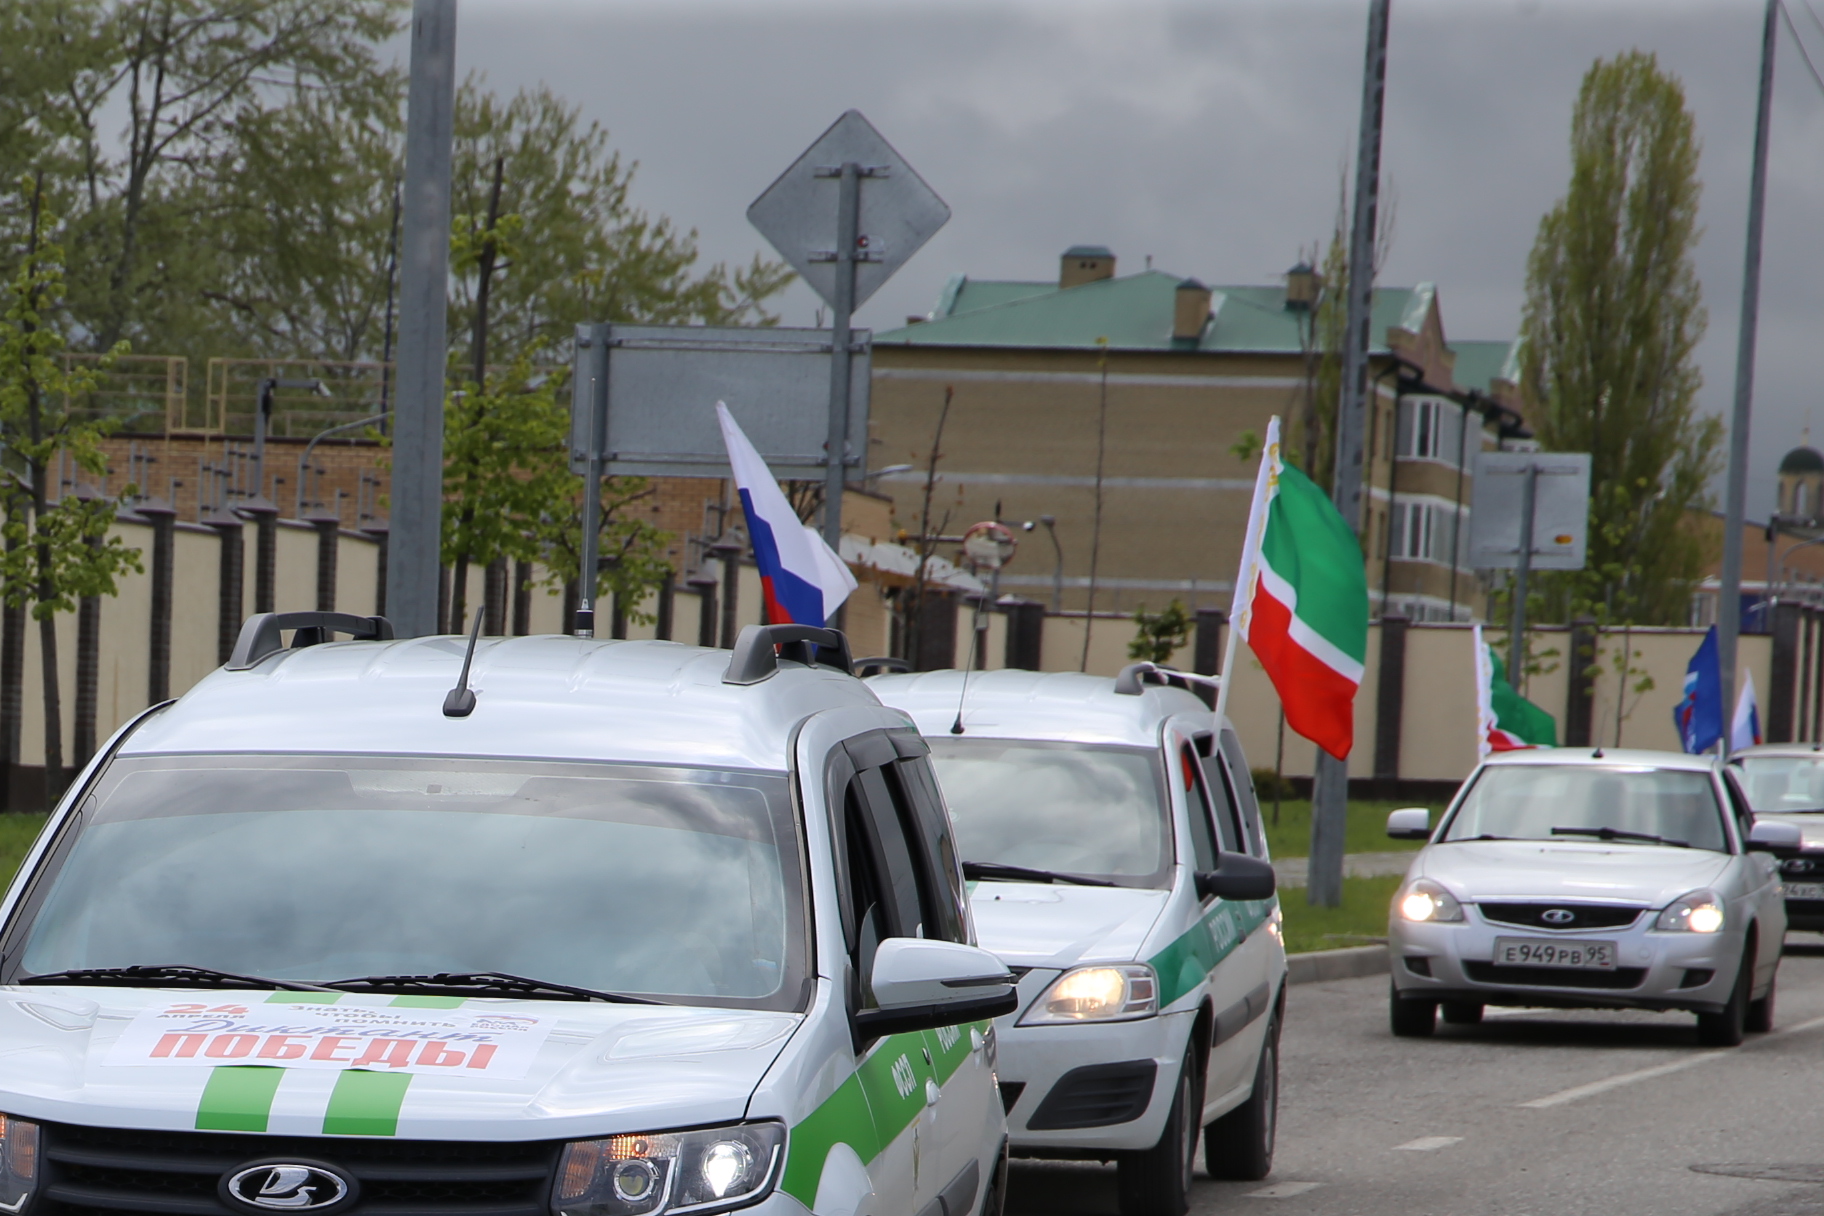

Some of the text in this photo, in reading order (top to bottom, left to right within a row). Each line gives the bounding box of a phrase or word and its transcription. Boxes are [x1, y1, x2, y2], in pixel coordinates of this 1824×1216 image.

[1588, 946, 1606, 960] 95
[163, 1004, 249, 1014] 24
[166, 1019, 504, 1041] Диктант
[149, 1033, 499, 1069] ПОБЕДЫ
[891, 1053, 917, 1100] ФССП
